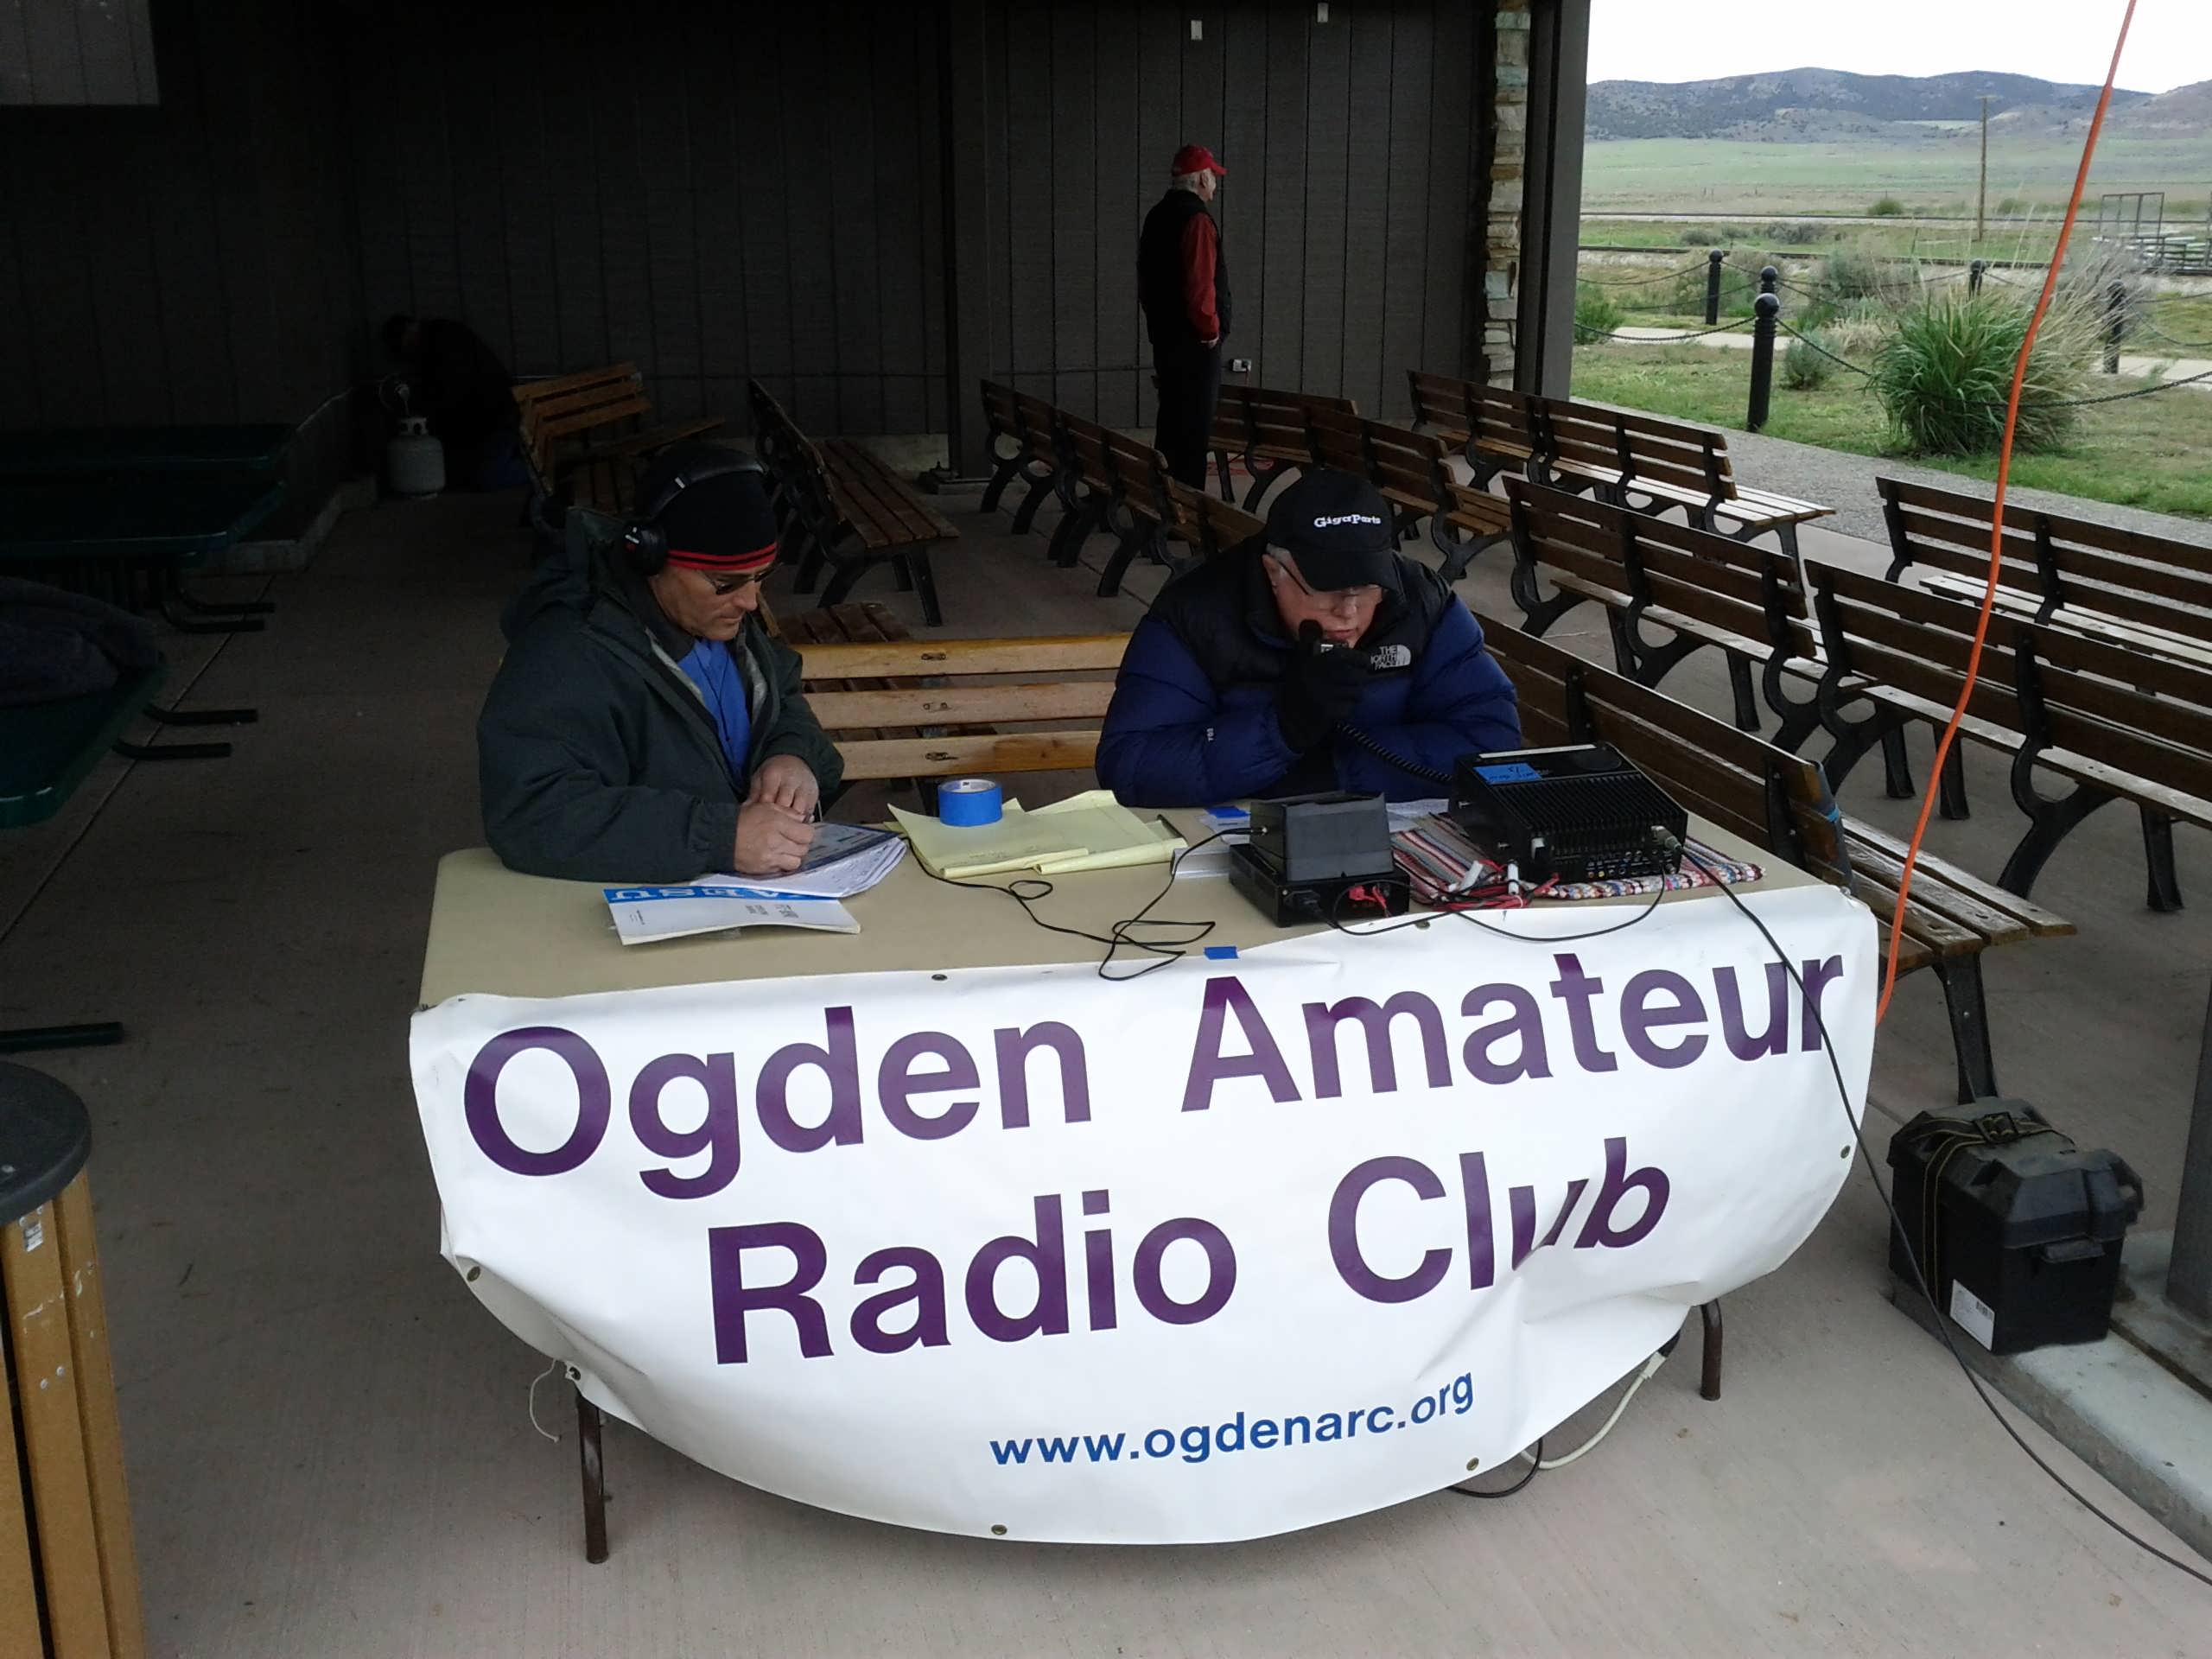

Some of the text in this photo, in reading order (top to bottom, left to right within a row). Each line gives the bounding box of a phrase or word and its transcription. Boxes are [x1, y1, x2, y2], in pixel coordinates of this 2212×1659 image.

[1314, 513, 1382, 528] GigaParts
[1379, 645, 1397, 656] THE
[464, 952, 1844, 1199] Ogden Amateur
[709, 1136, 1671, 1364] Radio Club
[989, 1372, 1474, 1465] www.ogdenarc.org
